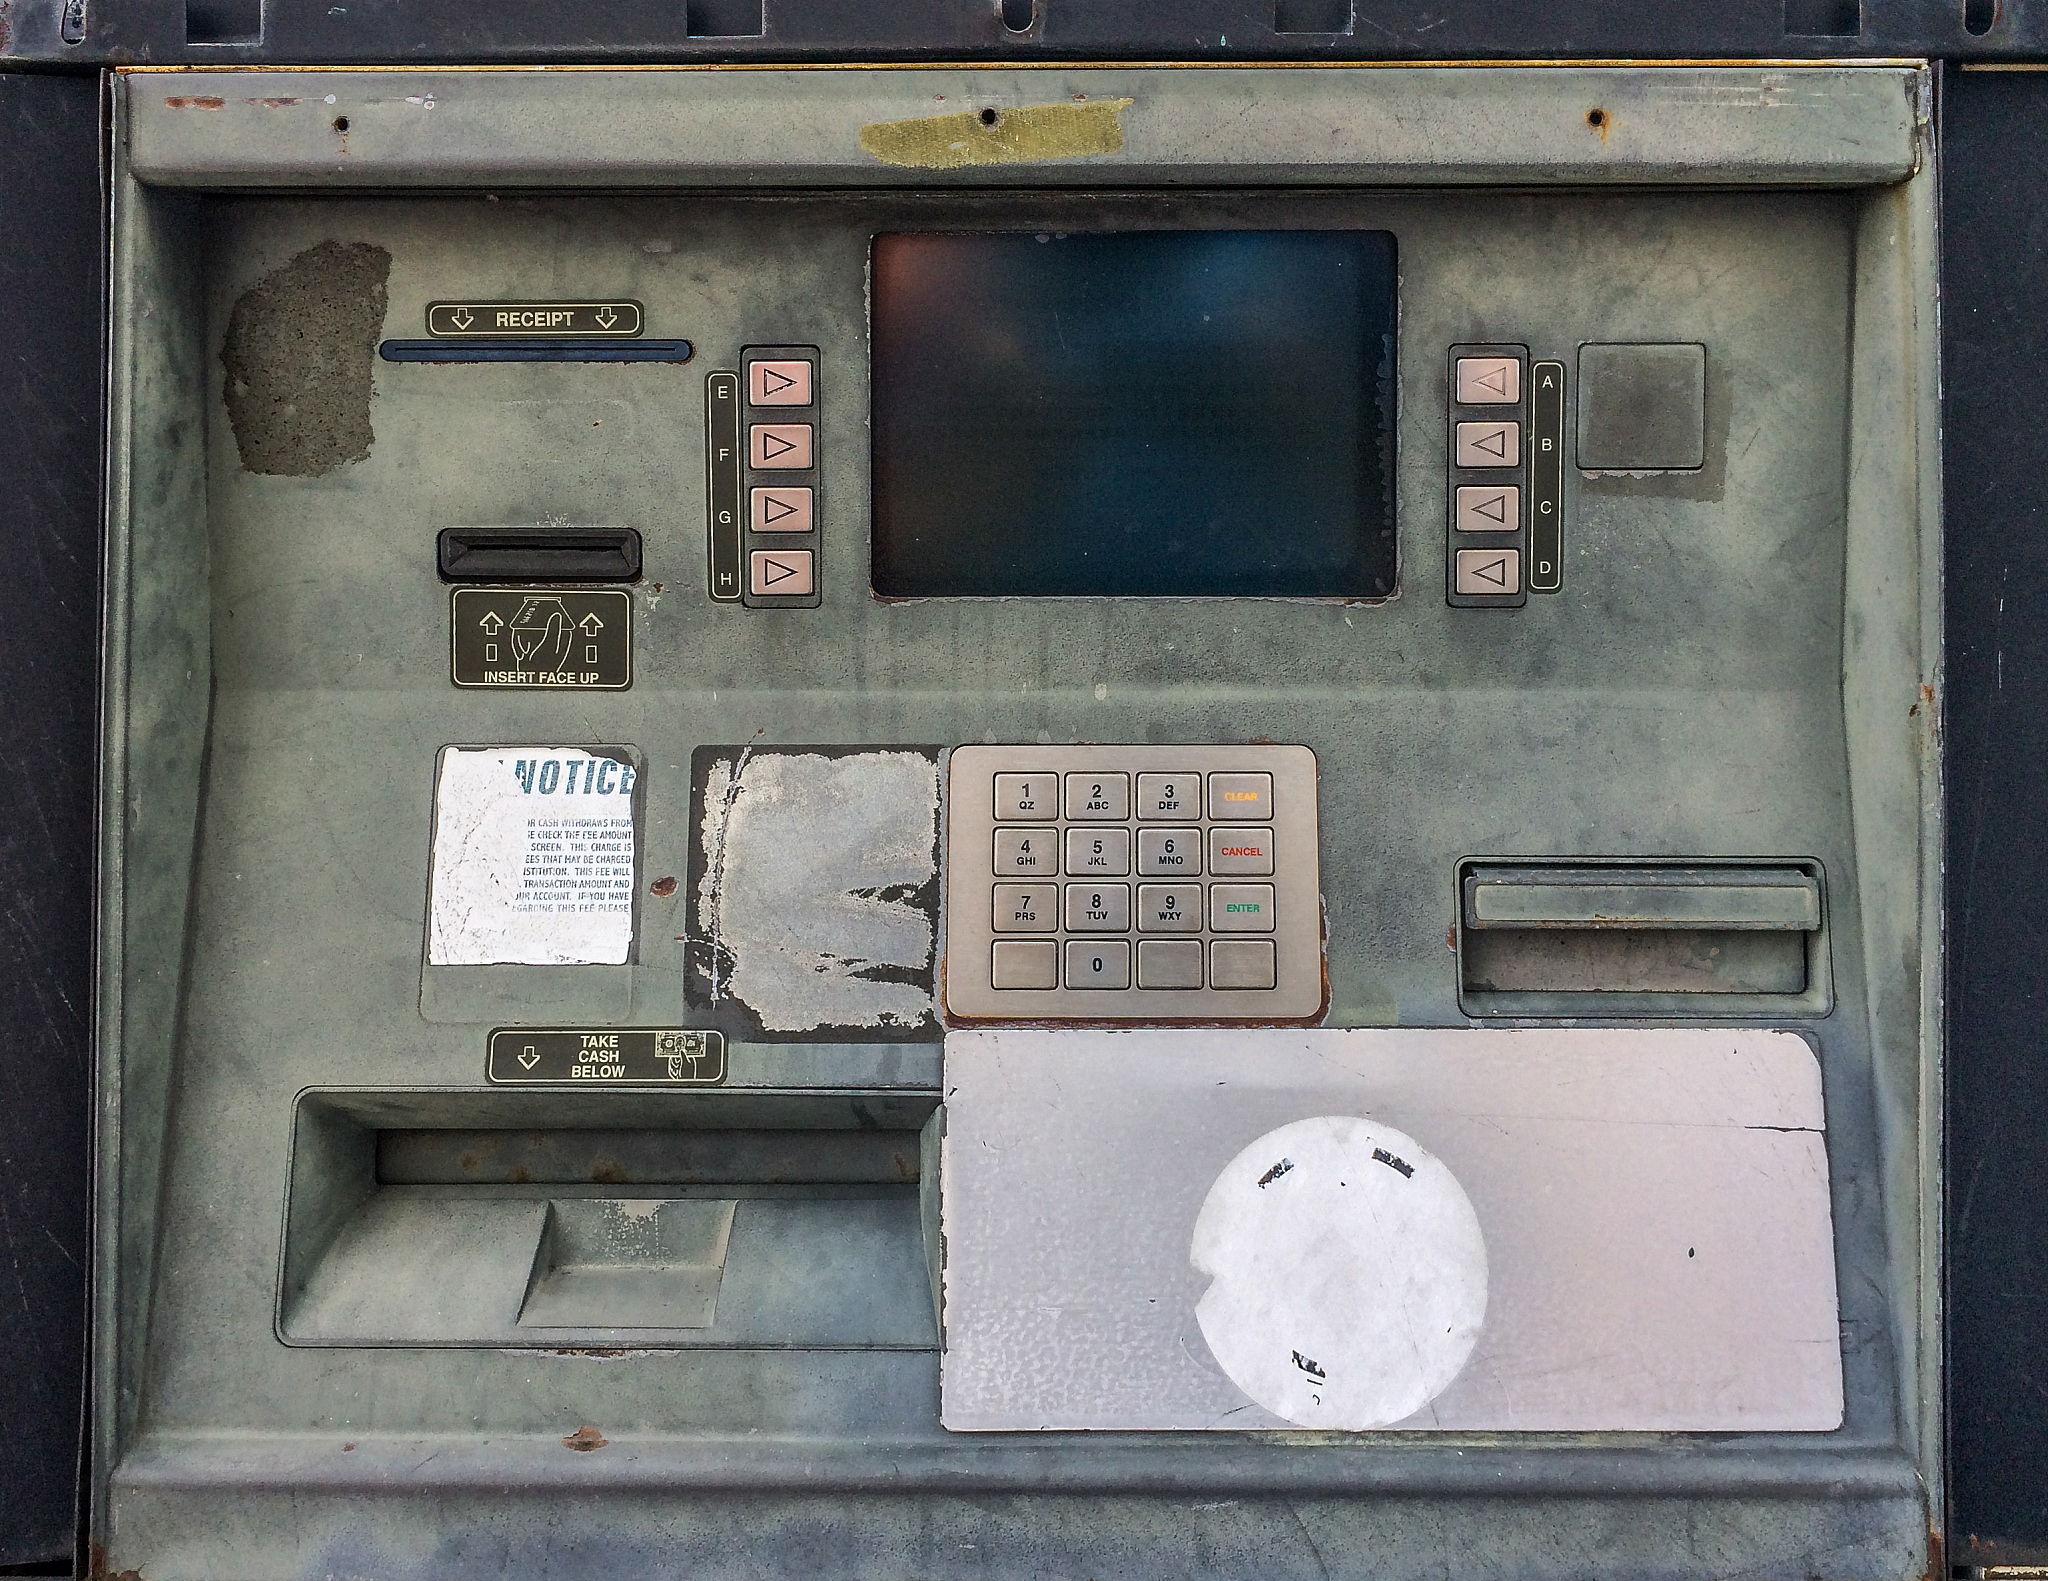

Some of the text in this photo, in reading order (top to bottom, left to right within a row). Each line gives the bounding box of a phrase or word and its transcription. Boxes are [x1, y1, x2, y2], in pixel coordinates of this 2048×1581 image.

[496, 311, 575, 327] RECEIPT
[1542, 376, 1553, 388] A
[718, 386, 728, 399] E
[1542, 439, 1552, 451] B
[719, 448, 729, 462] F
[1540, 501, 1552, 514] C
[719, 511, 731, 525] G
[1539, 561, 1551, 574] D
[720, 572, 732, 586] H
[484, 671, 599, 685] INSERT FACE UP
[1021, 783, 1030, 797] 1
[1092, 784, 1102, 799] 2
[1164, 784, 1175, 799] 3
[1224, 791, 1258, 802] CLEAR
[1018, 800, 1035, 811] QZ
[1086, 801, 1109, 811] ABC
[1158, 801, 1180, 811] DEF
[538, 819, 558, 827] CASH
[537, 830, 563, 839] CHECK
[599, 830, 632, 839] AMOUNT
[590, 842, 622, 852] CHARGE
[624, 842, 632, 852] IS
[1020, 839, 1031, 854] 4
[1092, 840, 1103, 854] 5
[1164, 839, 1175, 854] 6
[1221, 846, 1263, 857] CANCEL
[542, 854, 563, 864] THAT
[564, 854, 581, 864] MAY
[583, 854, 594, 864] BE
[596, 854, 631, 864] CHARGED
[1016, 856, 1036, 866] GHI
[1088, 856, 1107, 866] JKL
[1158, 856, 1184, 865] MNO
[575, 867, 593, 876] THIS
[595, 867, 610, 876] FEE
[612, 867, 631, 876] WILL
[524, 879, 630, 889] TRANSACTION AMOUNT AND
[578, 892, 586, 901] IF
[589, 892, 605, 901] YOU
[608, 892, 629, 901] HAVE
[1091, 894, 1101, 909] 8
[1165, 895, 1176, 910] 9
[557, 904, 576, 913] THIS
[579, 904, 596, 913] FEE
[598, 904, 629, 913] PLEASE
[1021, 896, 1031, 910] 7
[1226, 903, 1260, 914] ENTER
[1015, 911, 1036, 921] PRS
[1086, 911, 1108, 921] TUV
[1158, 911, 1182, 921] WXY
[1092, 957, 1102, 972] 0
[580, 1035, 619, 1048] TAKE
[578, 1050, 619, 1063] CASH
[571, 1065, 626, 1078] BELOW
